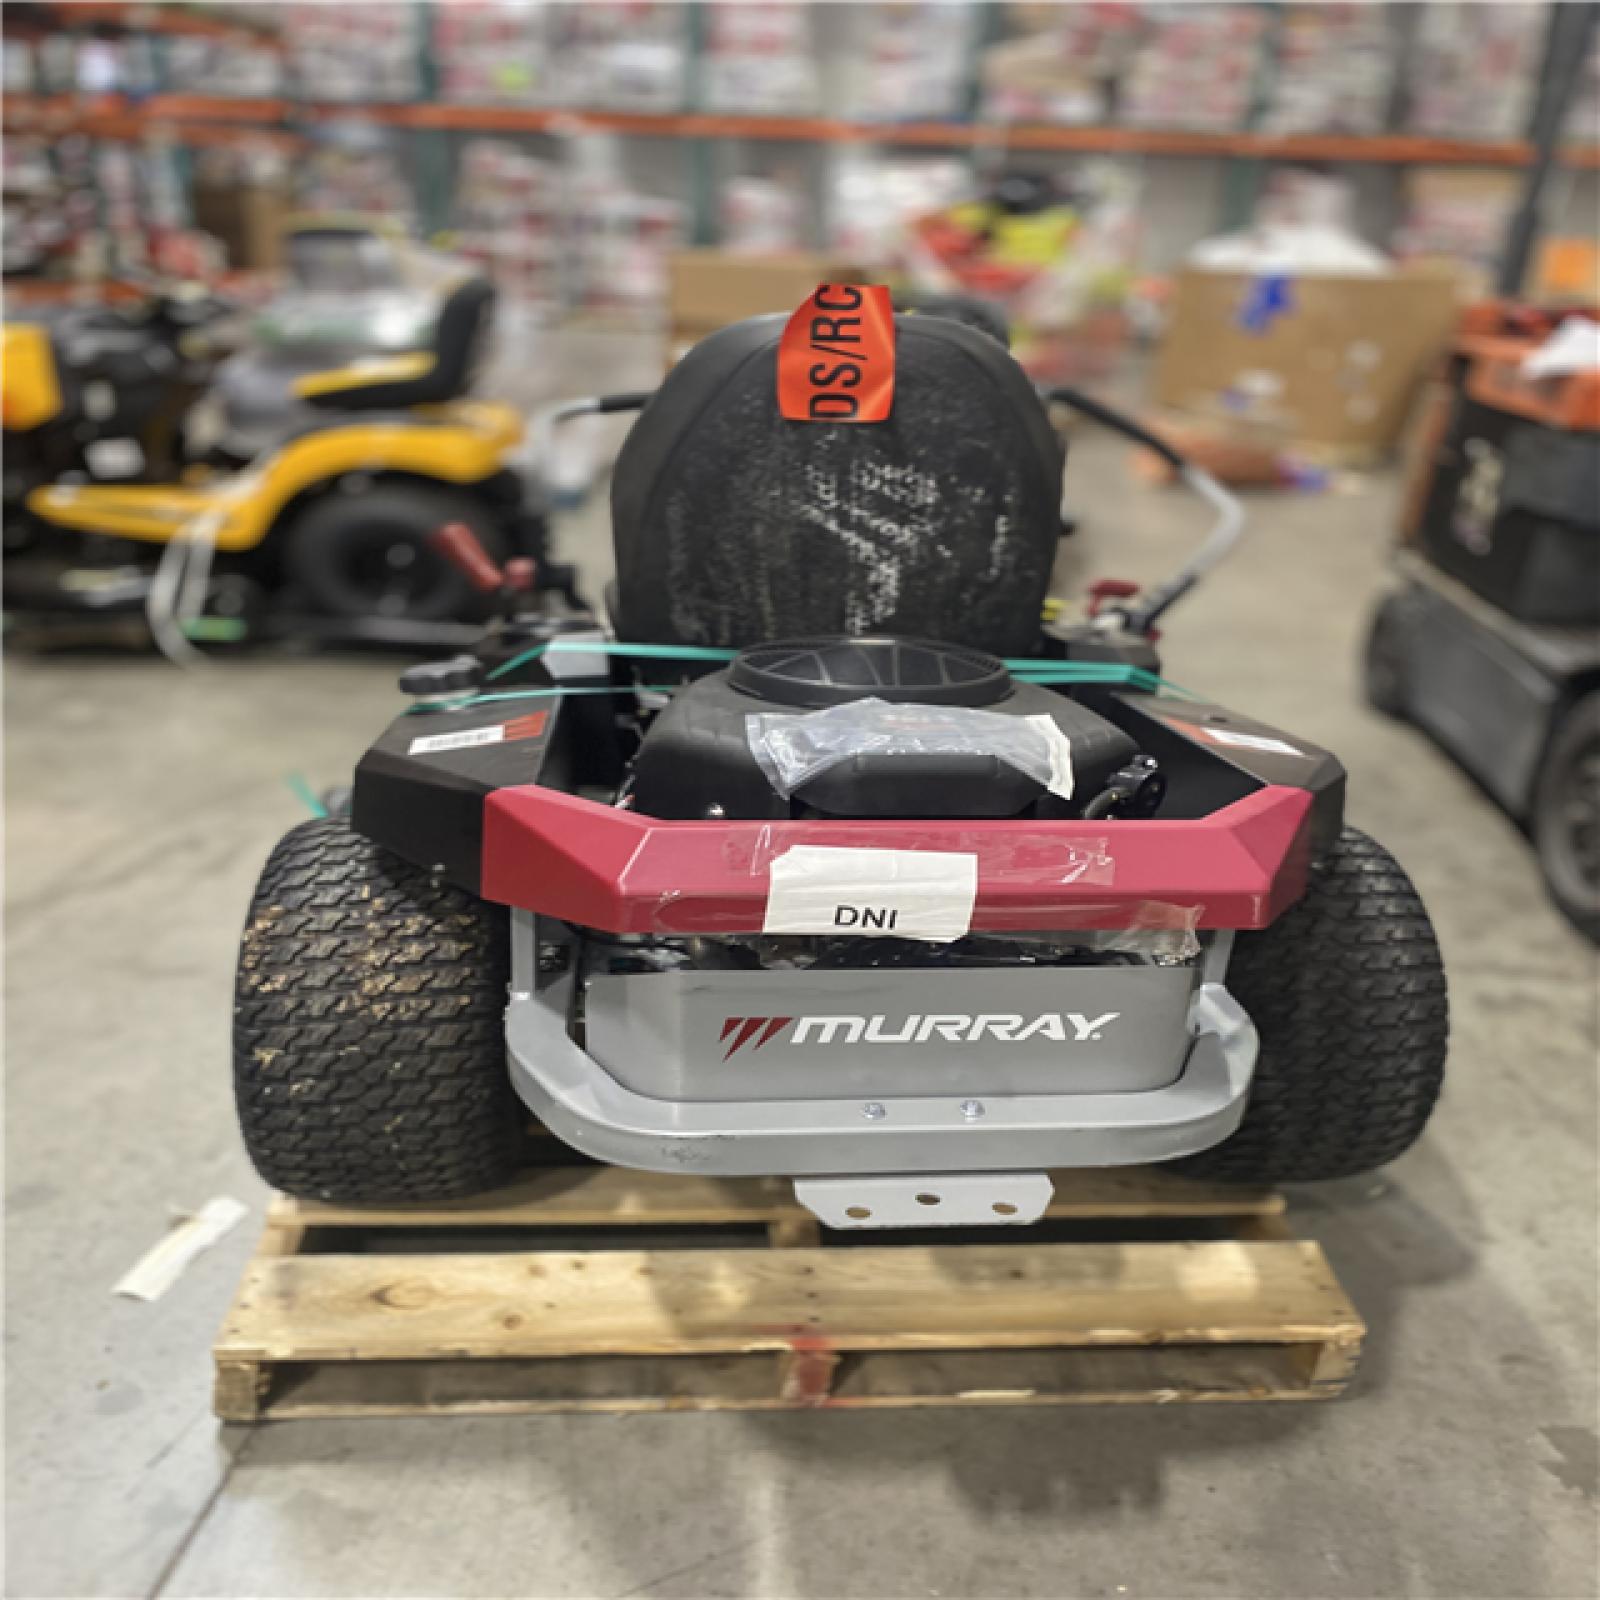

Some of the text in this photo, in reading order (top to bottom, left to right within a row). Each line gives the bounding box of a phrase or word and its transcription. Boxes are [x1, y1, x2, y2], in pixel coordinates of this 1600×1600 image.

[809, 284, 868, 418] DS/RC
[834, 904, 898, 930] DNI
[790, 1012, 1120, 1044] MURRAY
